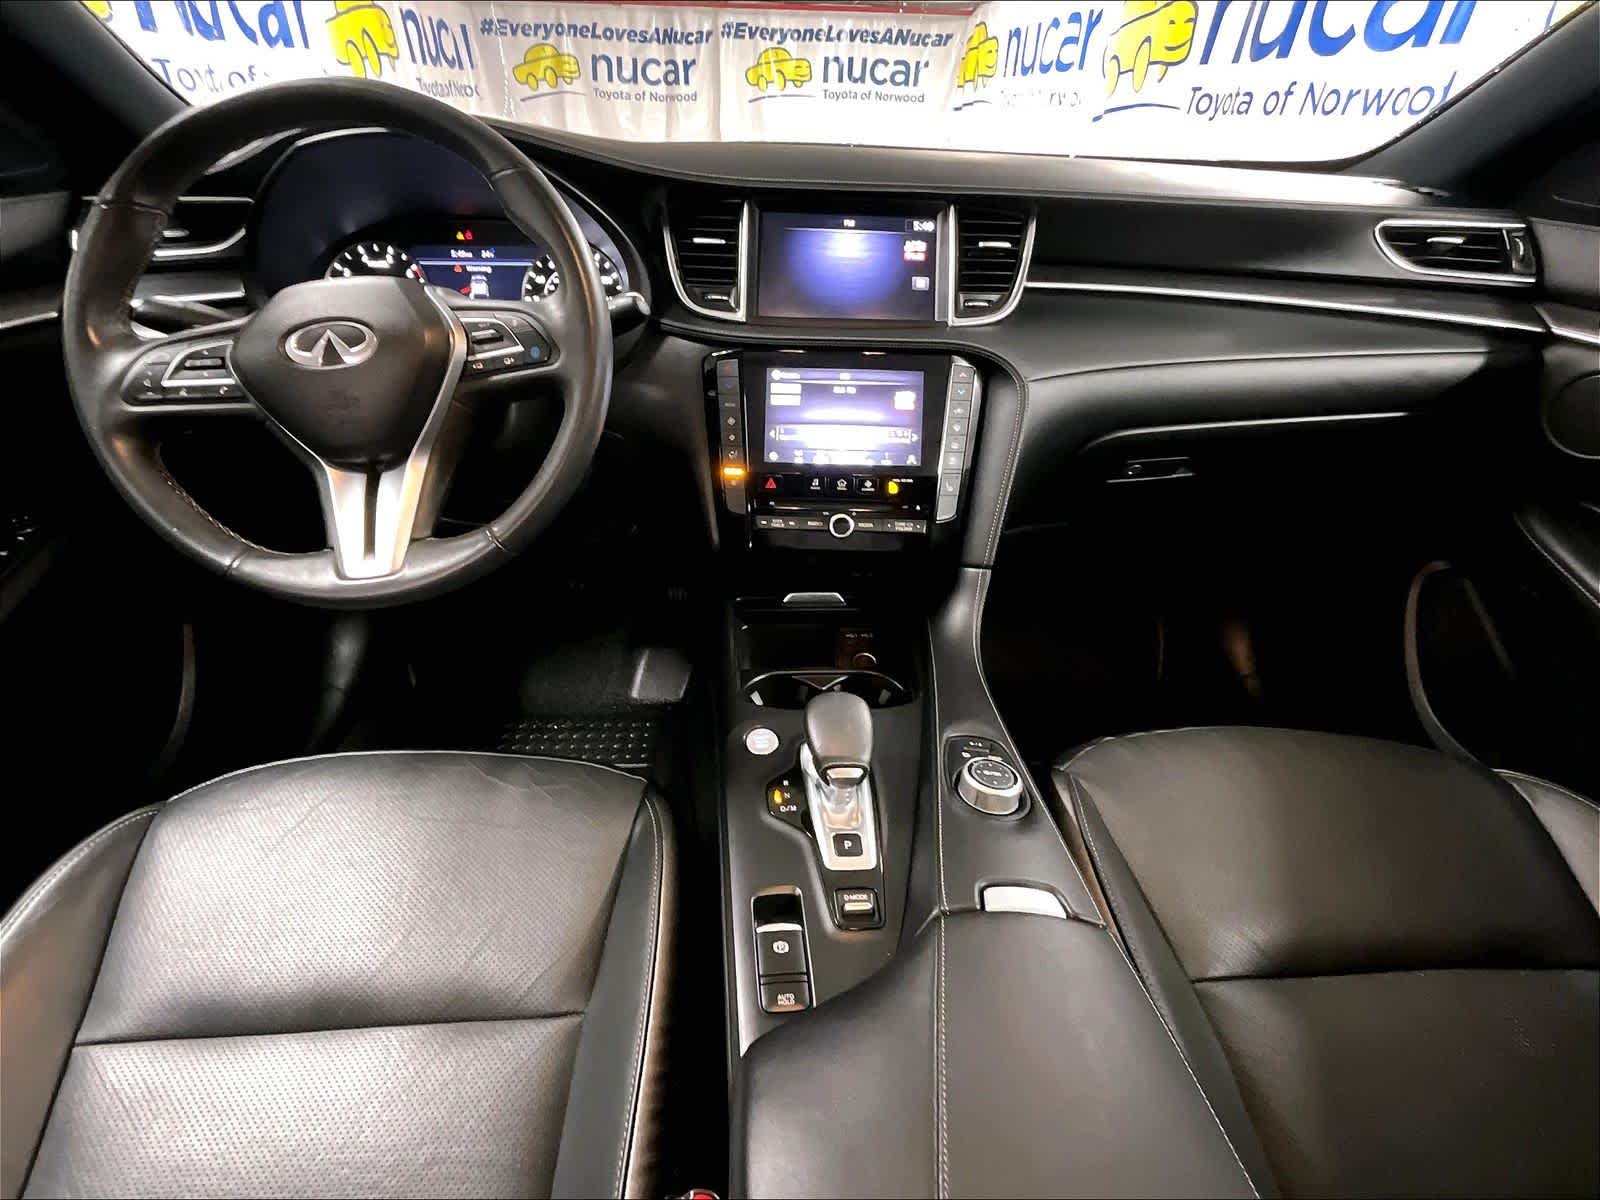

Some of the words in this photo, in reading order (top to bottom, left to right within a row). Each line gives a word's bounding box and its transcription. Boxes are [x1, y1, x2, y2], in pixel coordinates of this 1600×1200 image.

[480, 18, 713, 45] #EveryoneLovesANucar
[720, 21, 954, 47] #EveryoneLovesANucar
[1003, 9, 1103, 77] nucar
[591, 53, 697, 86] nucar
[822, 55, 930, 87] nucar
[593, 88, 631, 100] Toyota
[634, 91, 646, 101] of
[649, 91, 697, 102] Norwood
[823, 89, 858, 101] Toyota
[860, 90, 872, 100] of
[875, 91, 925, 103] Norwood
[1187, 86, 1254, 121] Toyota
[1263, 81, 1297, 116] of
